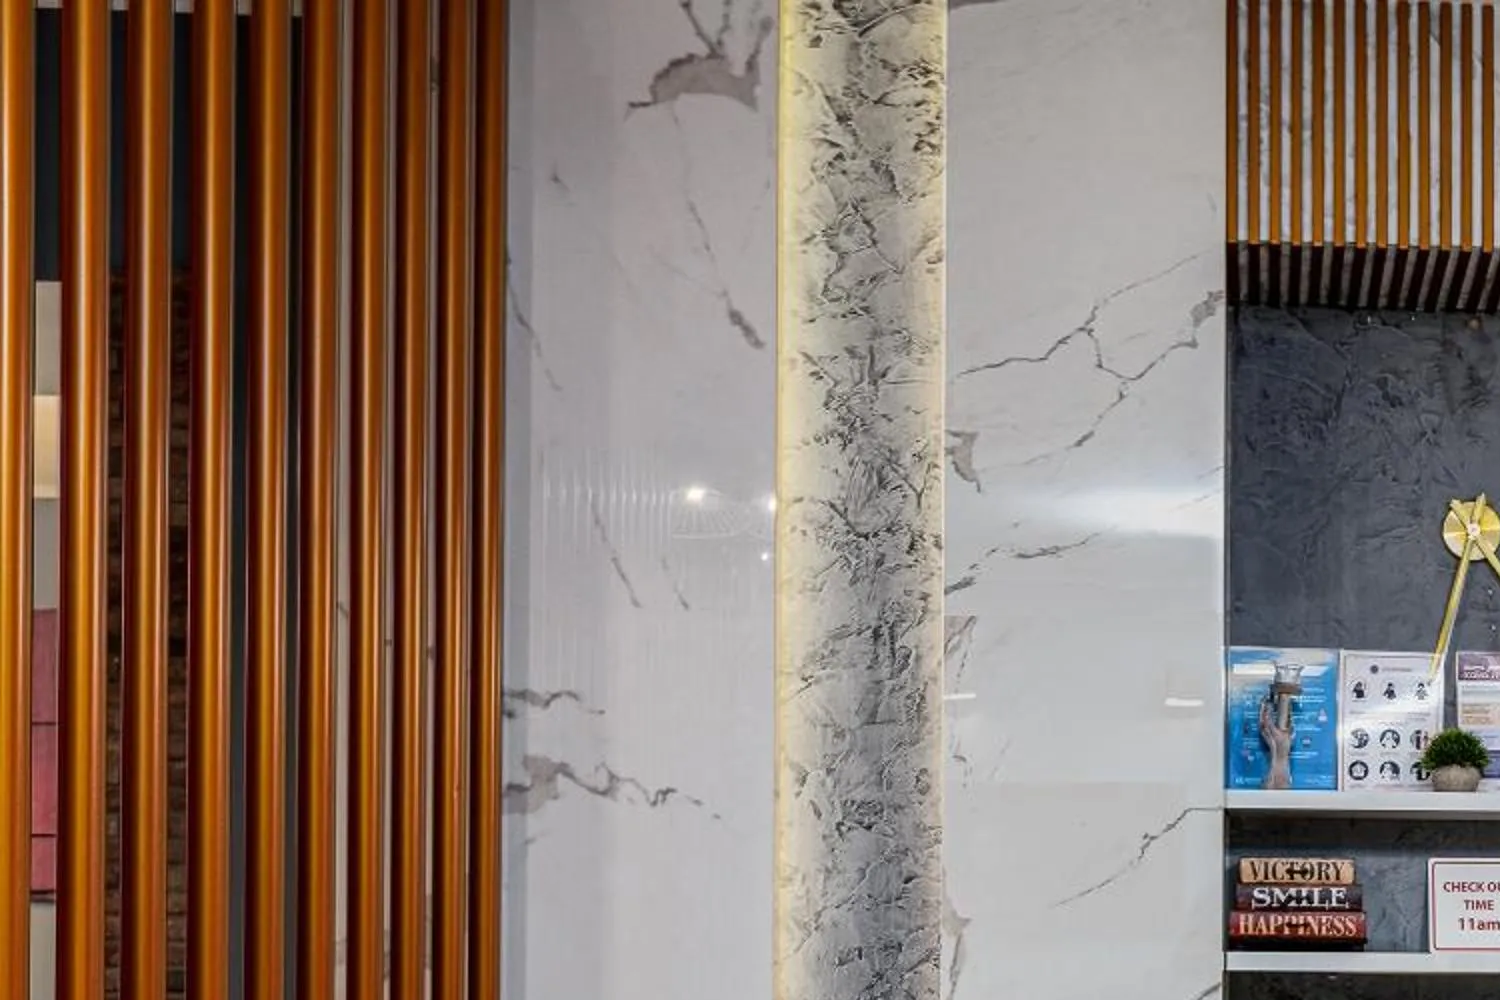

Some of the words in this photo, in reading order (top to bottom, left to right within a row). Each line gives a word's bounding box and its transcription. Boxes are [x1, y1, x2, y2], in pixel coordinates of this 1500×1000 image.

[1249, 861, 1345, 881] VICTORY
[1443, 881, 1485, 893] CHECK
[1251, 886, 1349, 909] SMILE
[1463, 899, 1495, 911] TIME
[1239, 914, 1358, 937] HAPPINESS
